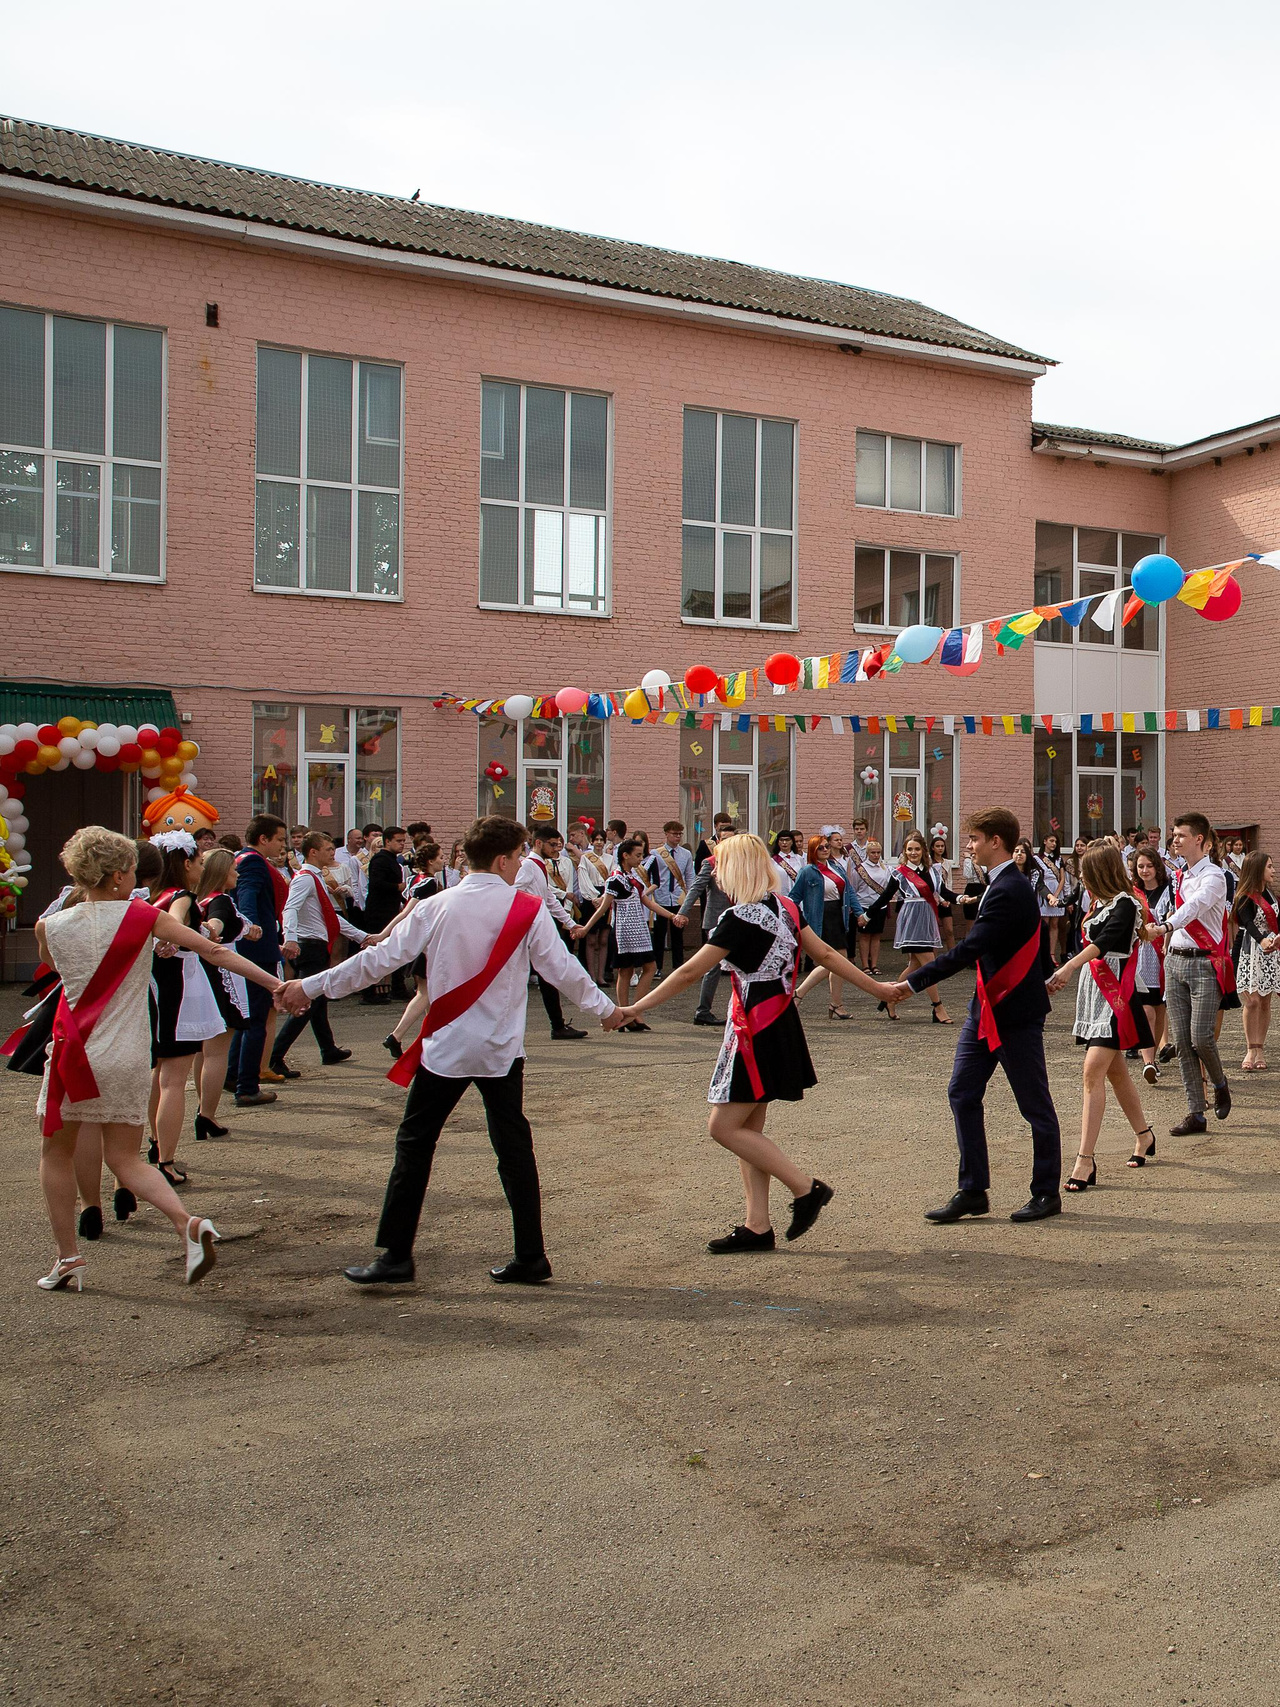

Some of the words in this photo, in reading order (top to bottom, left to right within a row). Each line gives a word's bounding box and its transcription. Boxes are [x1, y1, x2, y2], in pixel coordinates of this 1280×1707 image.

[690, 741, 703, 756] Б
[932, 747, 944, 760] Е
[1046, 746, 1057, 759] Б
[1131, 749, 1142, 761] Е
[264, 765, 277, 779] А
[369, 787, 382, 801] А
[492, 784, 505, 799] А
[931, 786, 943, 802] 4
[1049, 817, 1060, 831] Е
